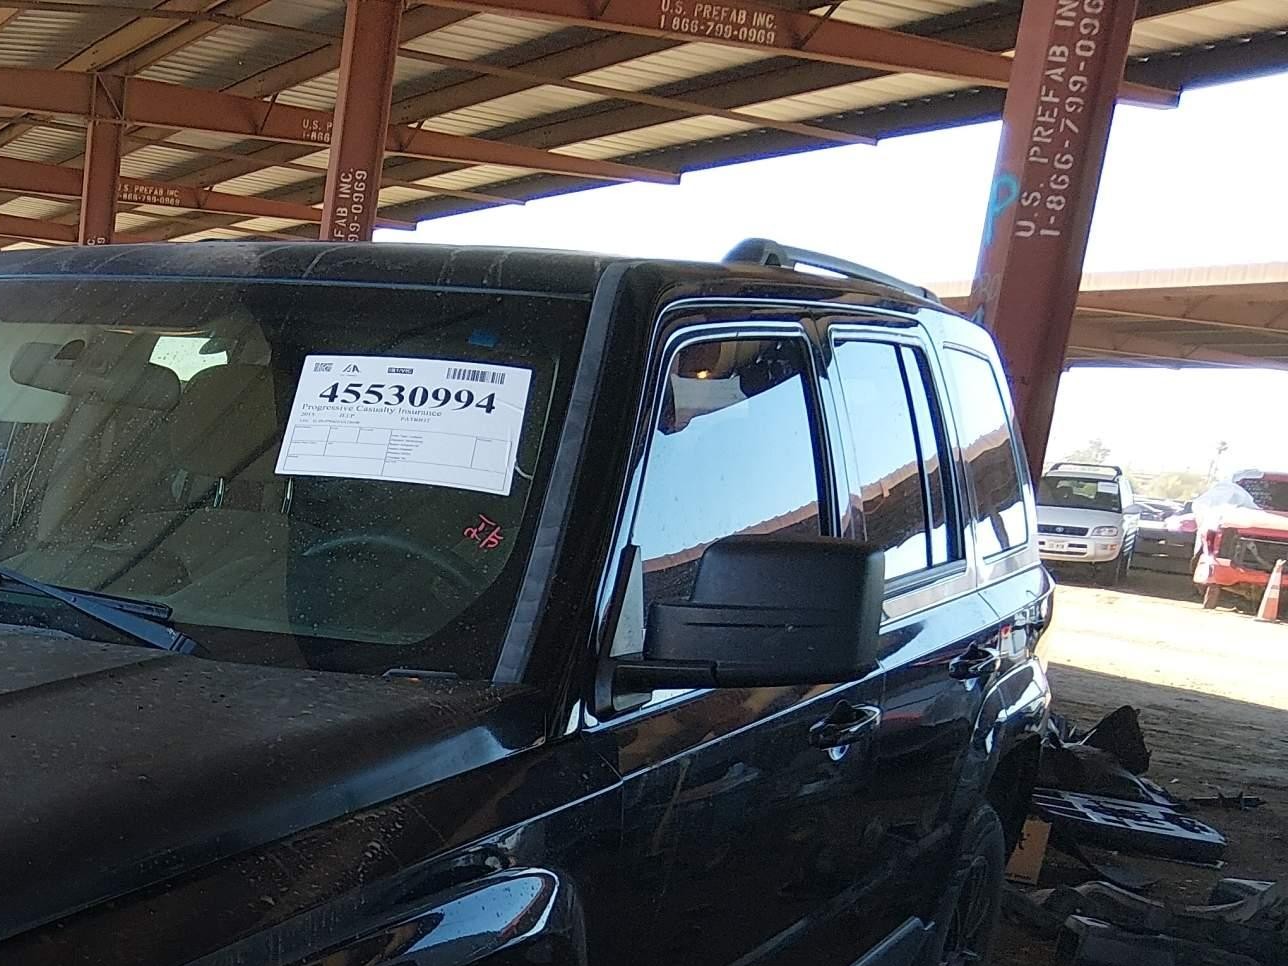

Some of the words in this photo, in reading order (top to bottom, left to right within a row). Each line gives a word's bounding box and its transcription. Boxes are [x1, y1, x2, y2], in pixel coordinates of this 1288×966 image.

[694, 4, 747, 25] PREFAB
[753, 12, 777, 29] INC.
[1028, 45, 1069, 163] PREFAB
[302, 119, 321, 130] U.S.
[338, 168, 354, 199] INC.
[1015, 184, 1045, 237] U.S.
[302, 403, 353, 412] Progressive
[356, 405, 395, 414] Casualty
[398, 407, 442, 417] Insurance
[319, 382, 496, 414] 45530994
